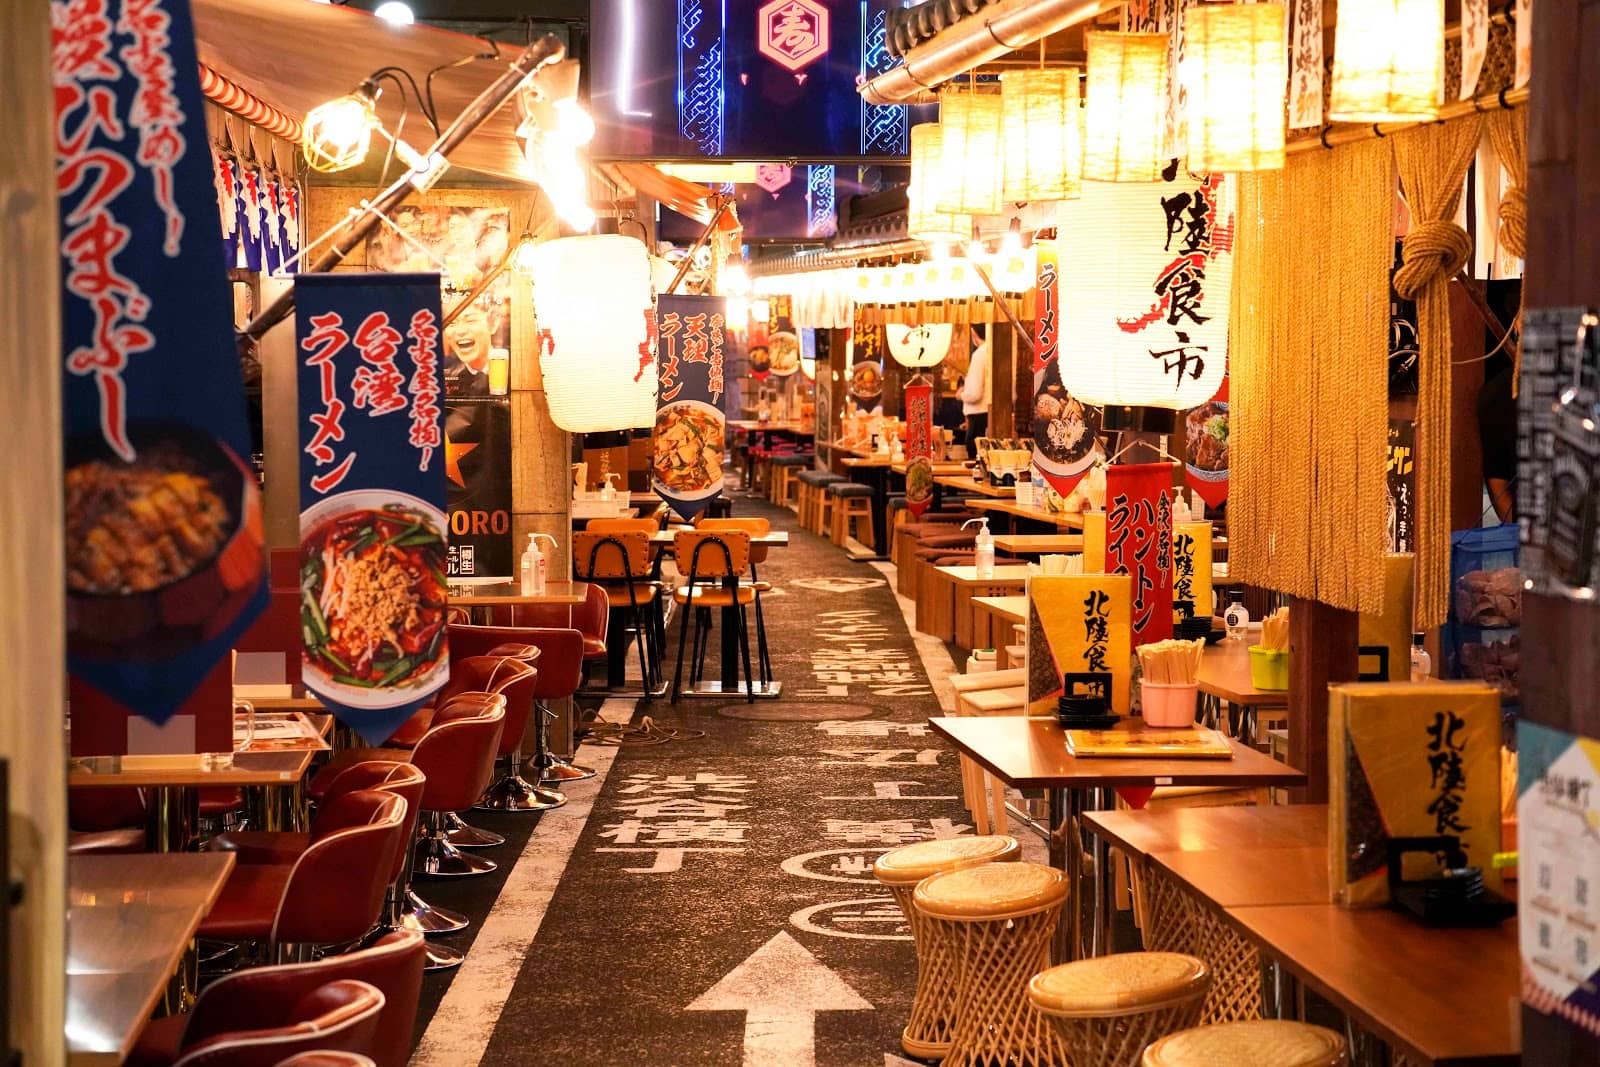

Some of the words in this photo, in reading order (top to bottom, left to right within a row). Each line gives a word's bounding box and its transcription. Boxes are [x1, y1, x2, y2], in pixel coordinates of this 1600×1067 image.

[1037, 263, 1058, 362] ラーメン
[1149, 158, 1212, 392] 陸食市
[351, 311, 408, 417] 台湾
[659, 312, 684, 402] ラーメン
[682, 312, 708, 364] 天理
[301, 311, 357, 493] ラーメン
[446, 509, 509, 536] ORO
[1108, 493, 1130, 577] ライ
[1131, 498, 1156, 633] ハントン
[594, 772, 758, 874] 渋谷横丁
